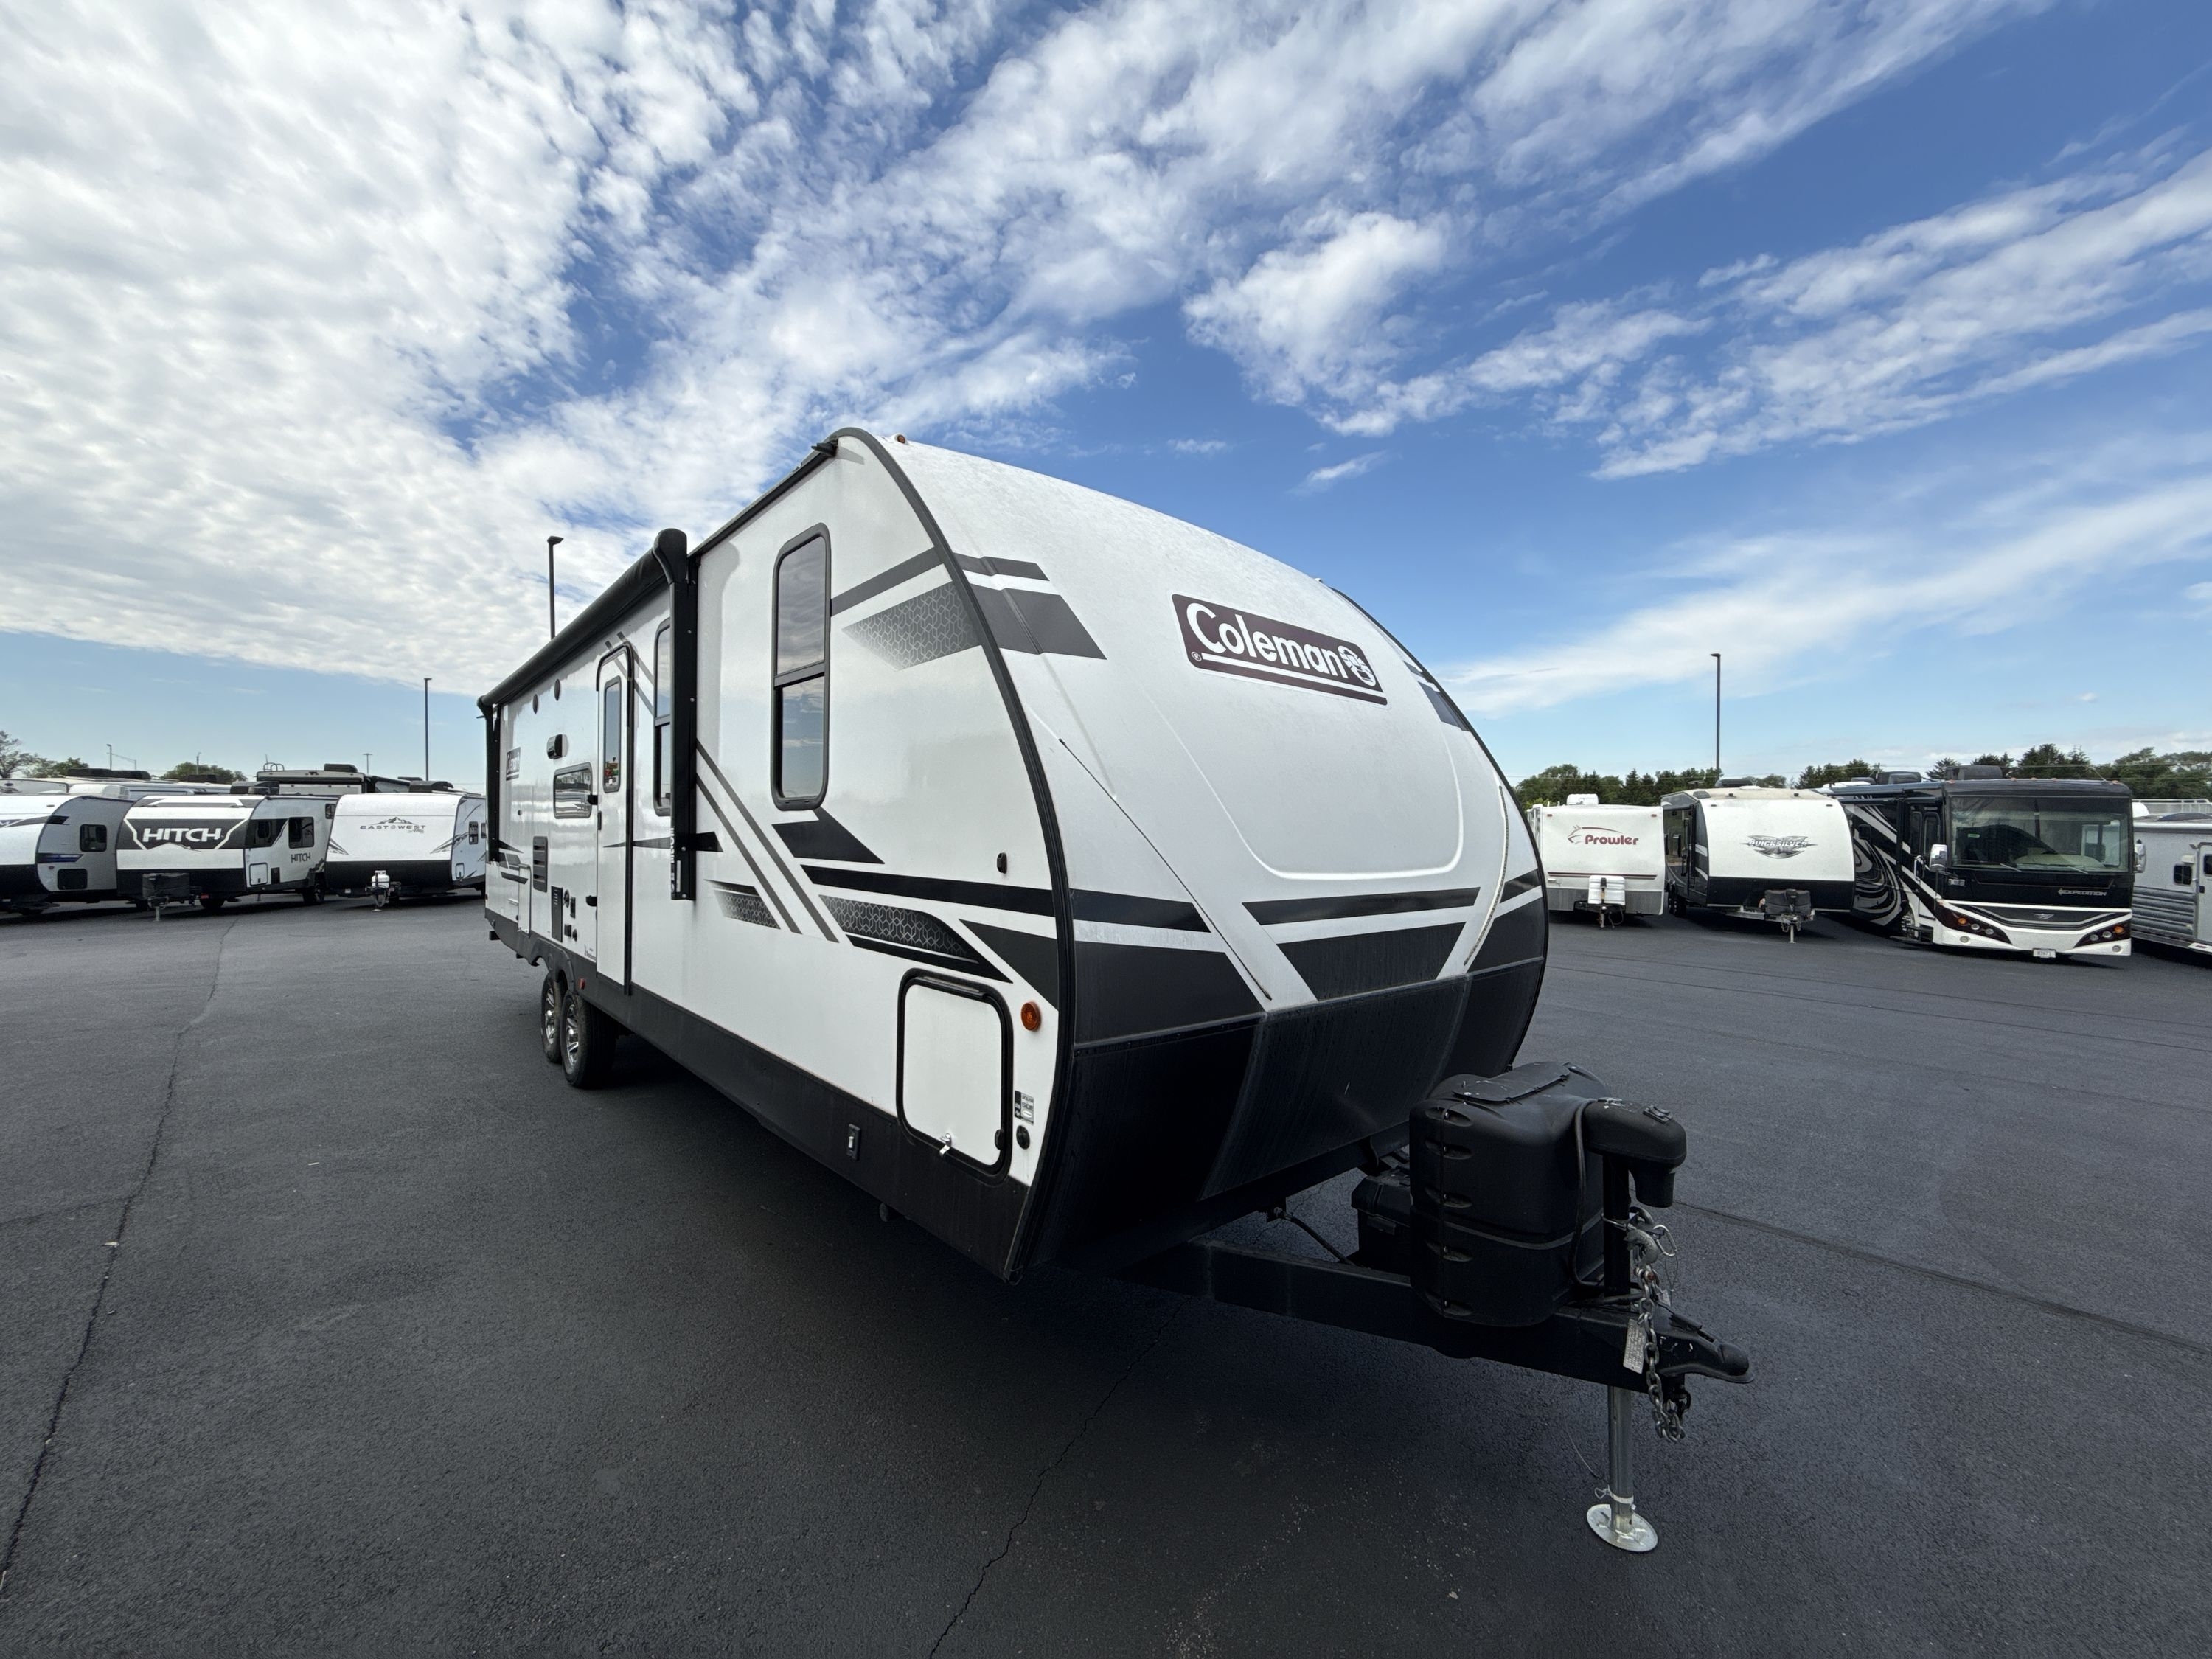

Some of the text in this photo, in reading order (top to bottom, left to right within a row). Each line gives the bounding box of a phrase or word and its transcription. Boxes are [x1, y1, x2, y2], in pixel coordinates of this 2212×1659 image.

[1186, 602, 1349, 679] Coleman
[142, 827, 222, 842] HITCH
[1585, 834, 1639, 845] Prowler
[1748, 840, 1808, 848] QUICKSILVER
[291, 852, 311, 863] HITCH
